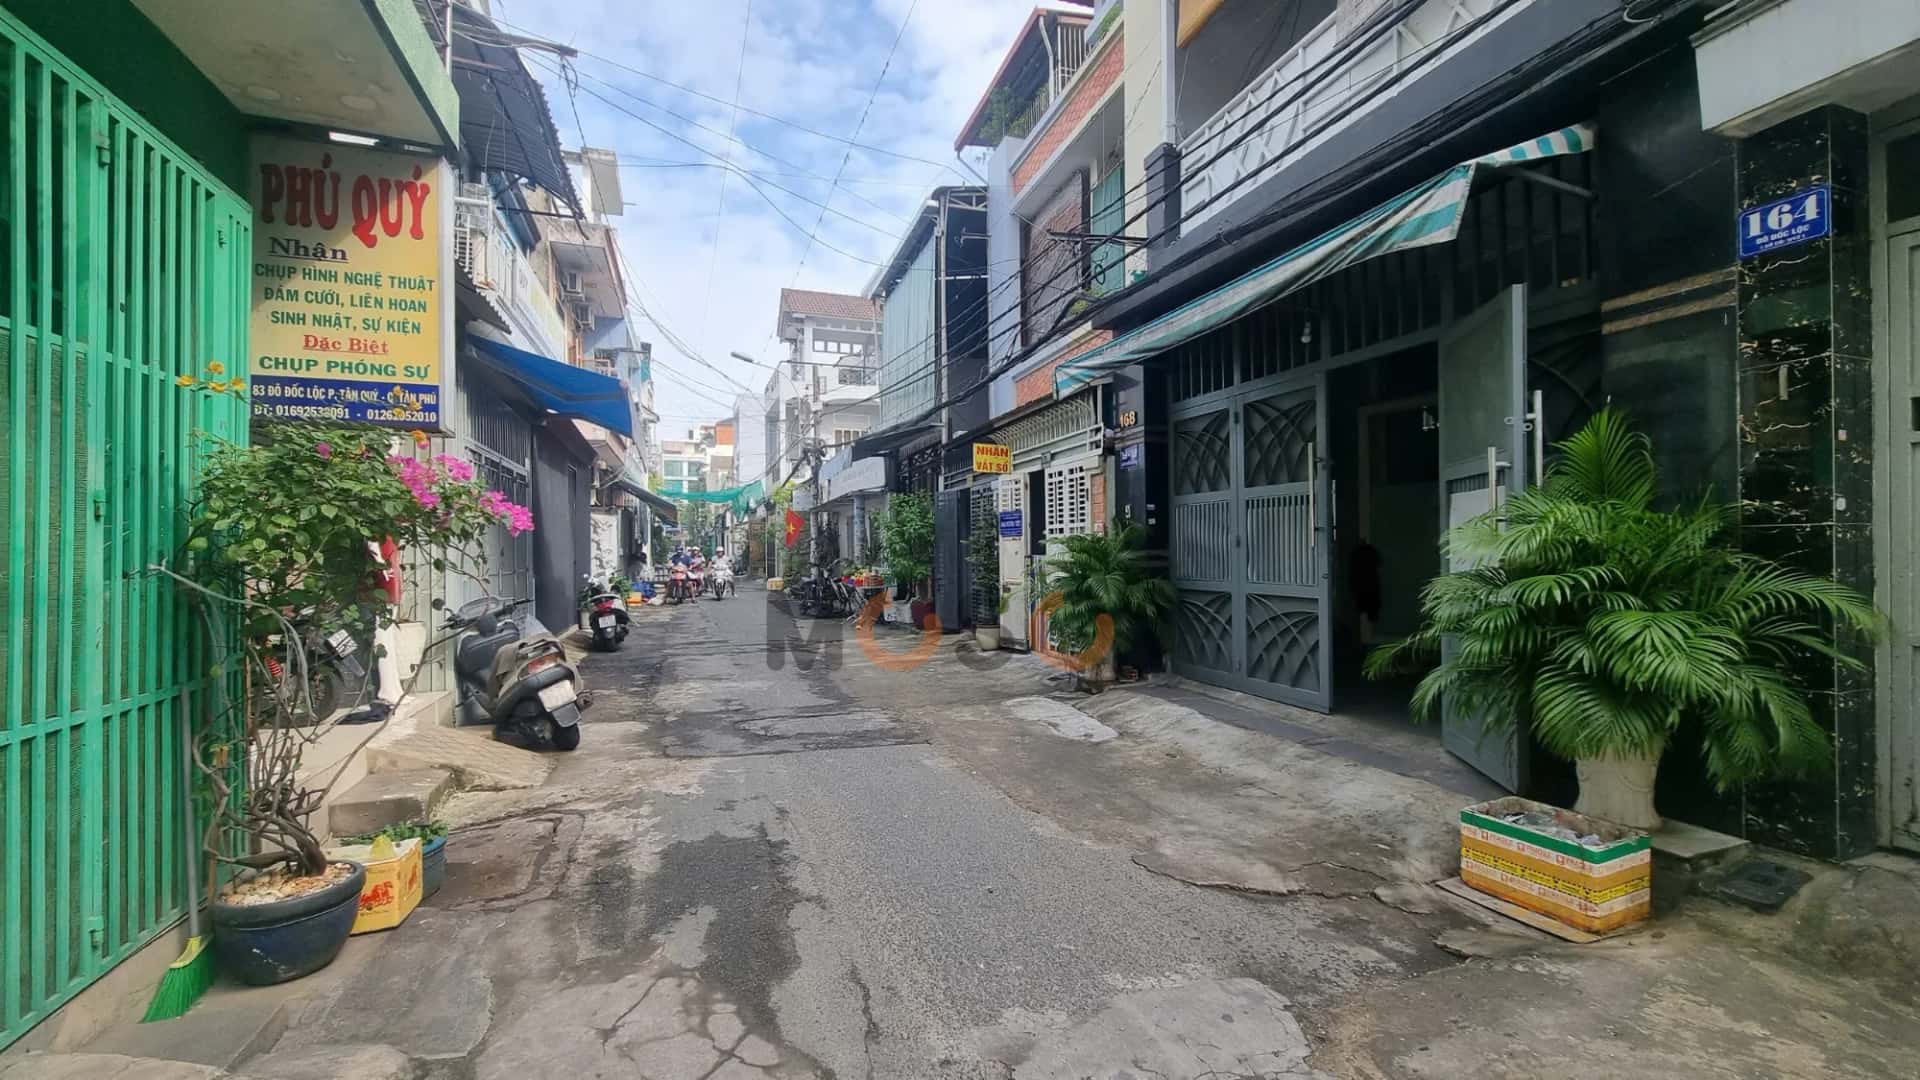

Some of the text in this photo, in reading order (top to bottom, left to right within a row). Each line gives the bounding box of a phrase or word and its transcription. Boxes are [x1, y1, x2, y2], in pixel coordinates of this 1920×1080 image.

[352, 164, 431, 249] QUÝ
[1745, 194, 1820, 239] 164
[254, 263, 435, 292] CHỤP HÌNH NGHỆ THUẬT
[350, 293, 384, 310] LIÊN
[388, 298, 427, 313] HOAN
[270, 311, 306, 325] SINH
[362, 316, 382, 334] SỰ
[387, 318, 421, 334] KIỆN
[259, 355, 431, 381] CHỤP PHÓNG SỰ
[252, 385, 265, 396] 83
